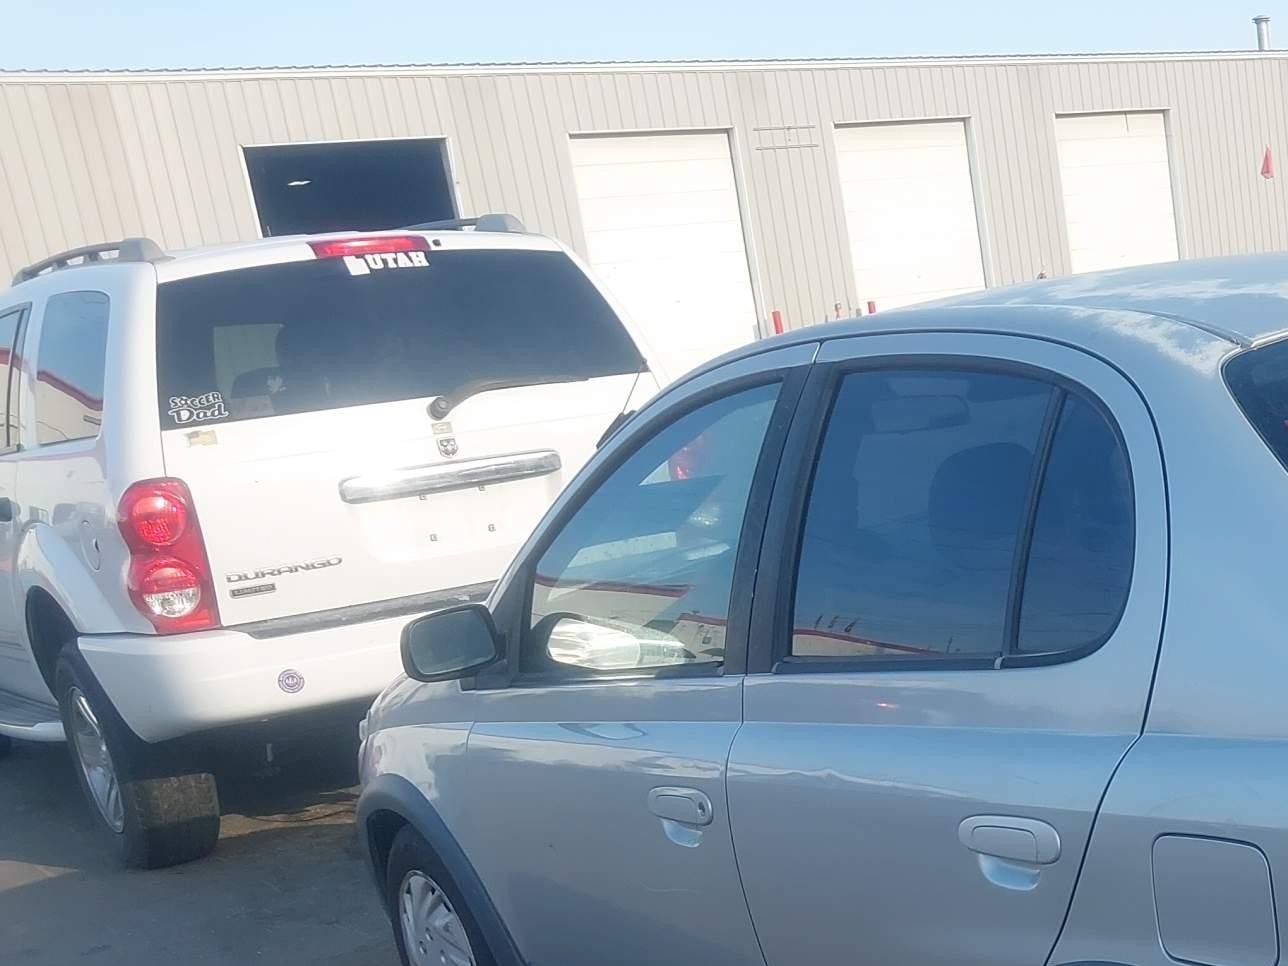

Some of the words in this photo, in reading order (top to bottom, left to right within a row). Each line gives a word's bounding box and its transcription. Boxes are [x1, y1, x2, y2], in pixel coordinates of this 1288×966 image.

[364, 251, 430, 270] UTAH
[169, 391, 223, 408] SOCCER
[168, 403, 229, 423] Dad
[226, 557, 343, 583] DURANGO
